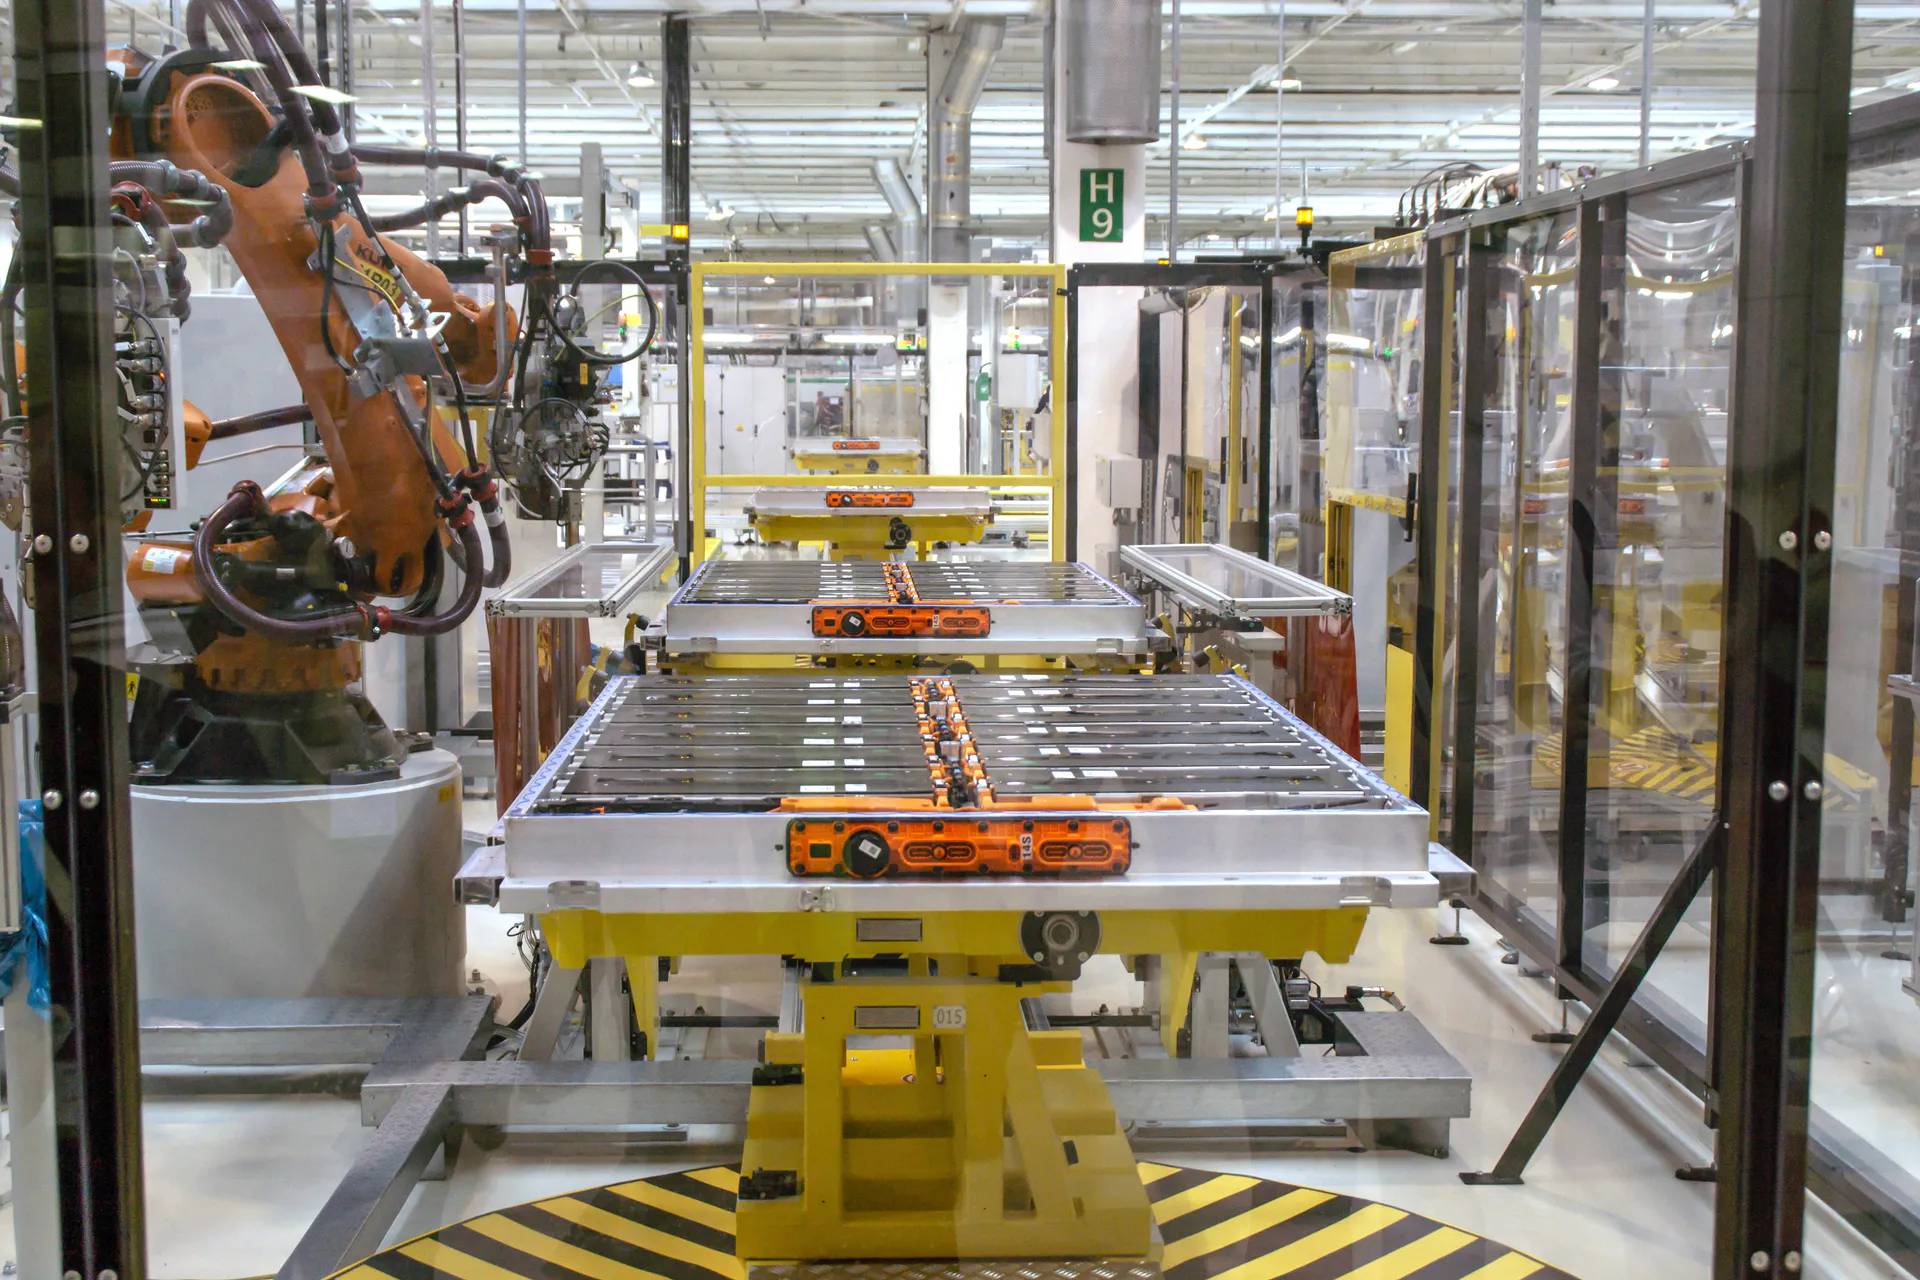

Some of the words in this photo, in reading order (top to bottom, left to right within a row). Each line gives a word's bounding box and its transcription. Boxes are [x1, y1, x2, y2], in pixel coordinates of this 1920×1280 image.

[1090, 172, 1113, 202] H
[1092, 208, 1112, 238] 9
[1022, 836, 1031, 858] 14S
[937, 1009, 962, 1024] 015
